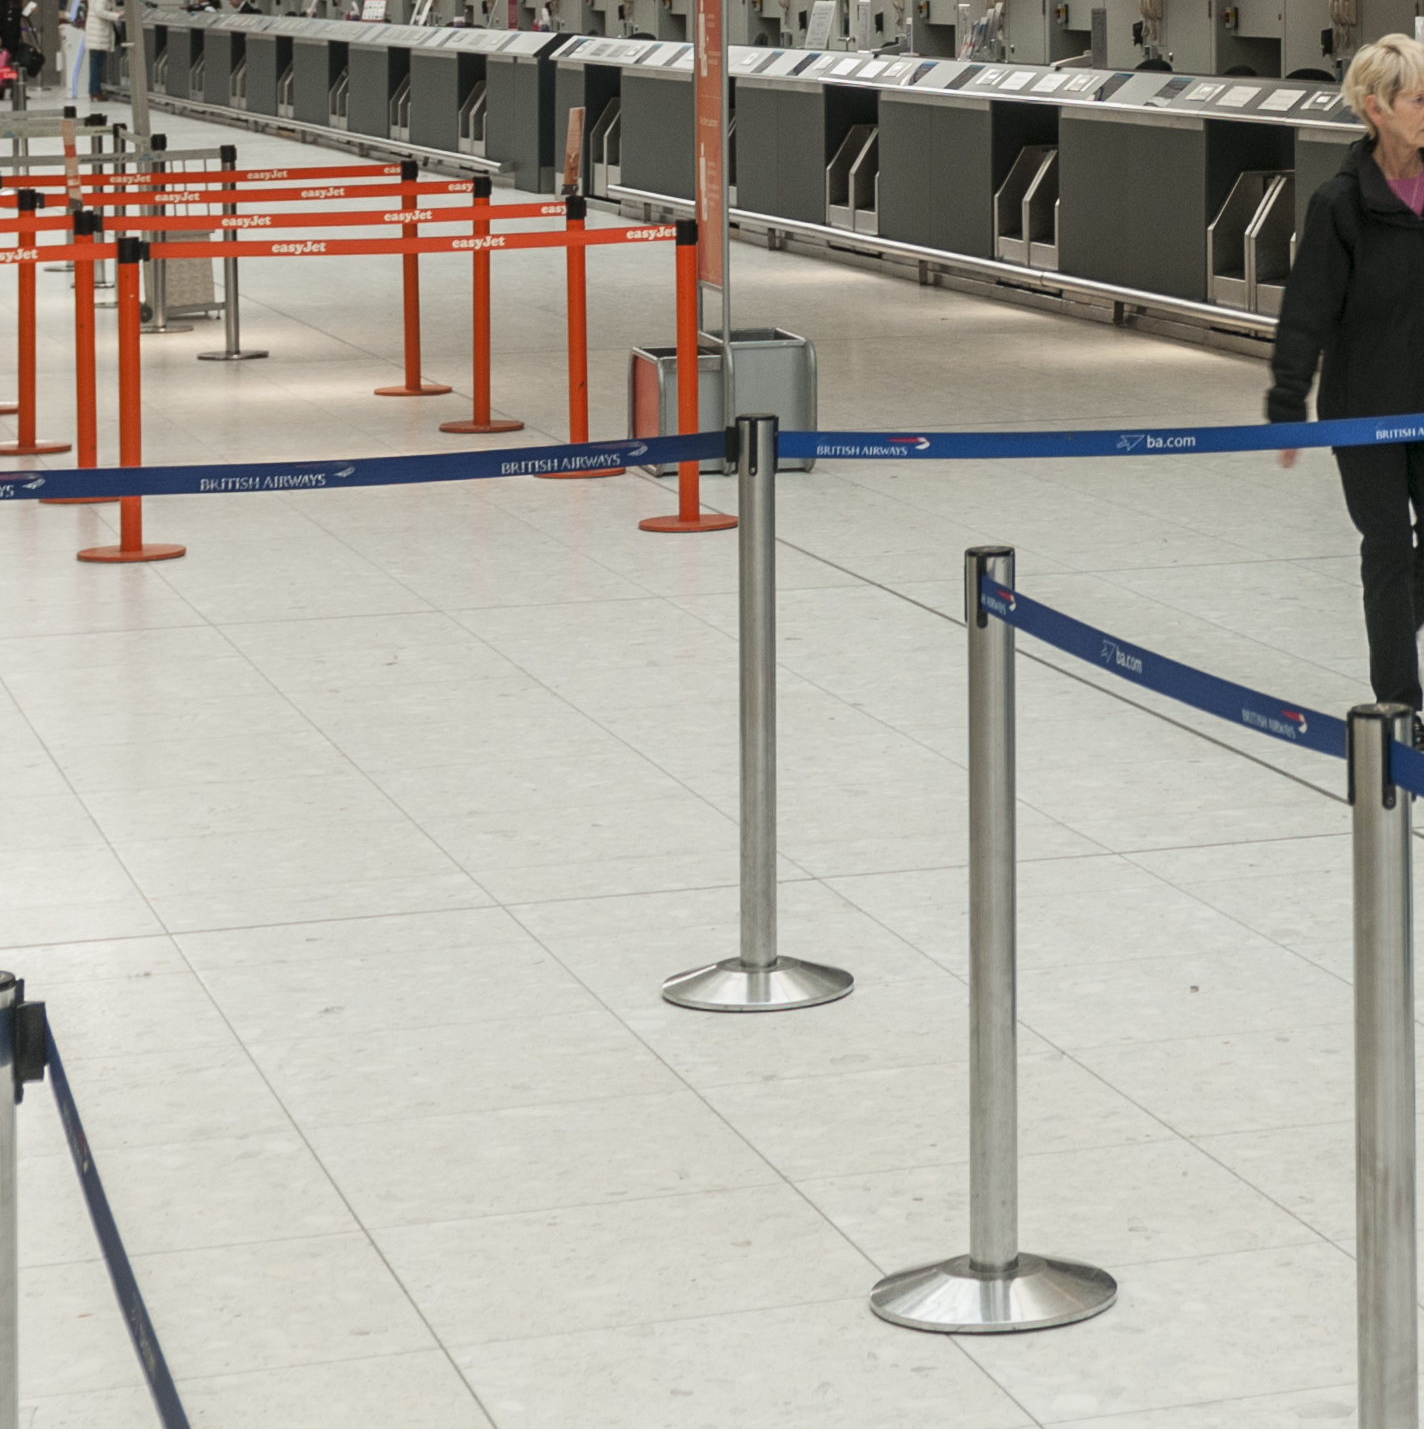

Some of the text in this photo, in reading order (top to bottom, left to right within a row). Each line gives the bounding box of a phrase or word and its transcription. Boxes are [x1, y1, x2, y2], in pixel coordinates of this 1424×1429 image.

[109, 170, 288, 184] easyJet easyJet
[155, 182, 474, 203] easyJet easyJet easy
[221, 205, 567, 228] easyJet easyJet easy
[0, 226, 677, 263] syJet easyJet easyJet easyJet
[1146, 434, 1196, 448] ba.com
[1376, 427, 1416, 440] BRITISH
[816, 445, 908, 456] BRITISH AIRWAYS
[501, 453, 621, 475] BRITISH AIRWAYS
[200, 473, 327, 492] BRITISH AIRWAYS
[1115, 645, 1143, 674] ba.com
[1241, 708, 1296, 740] BRITISH AIRWAYS
